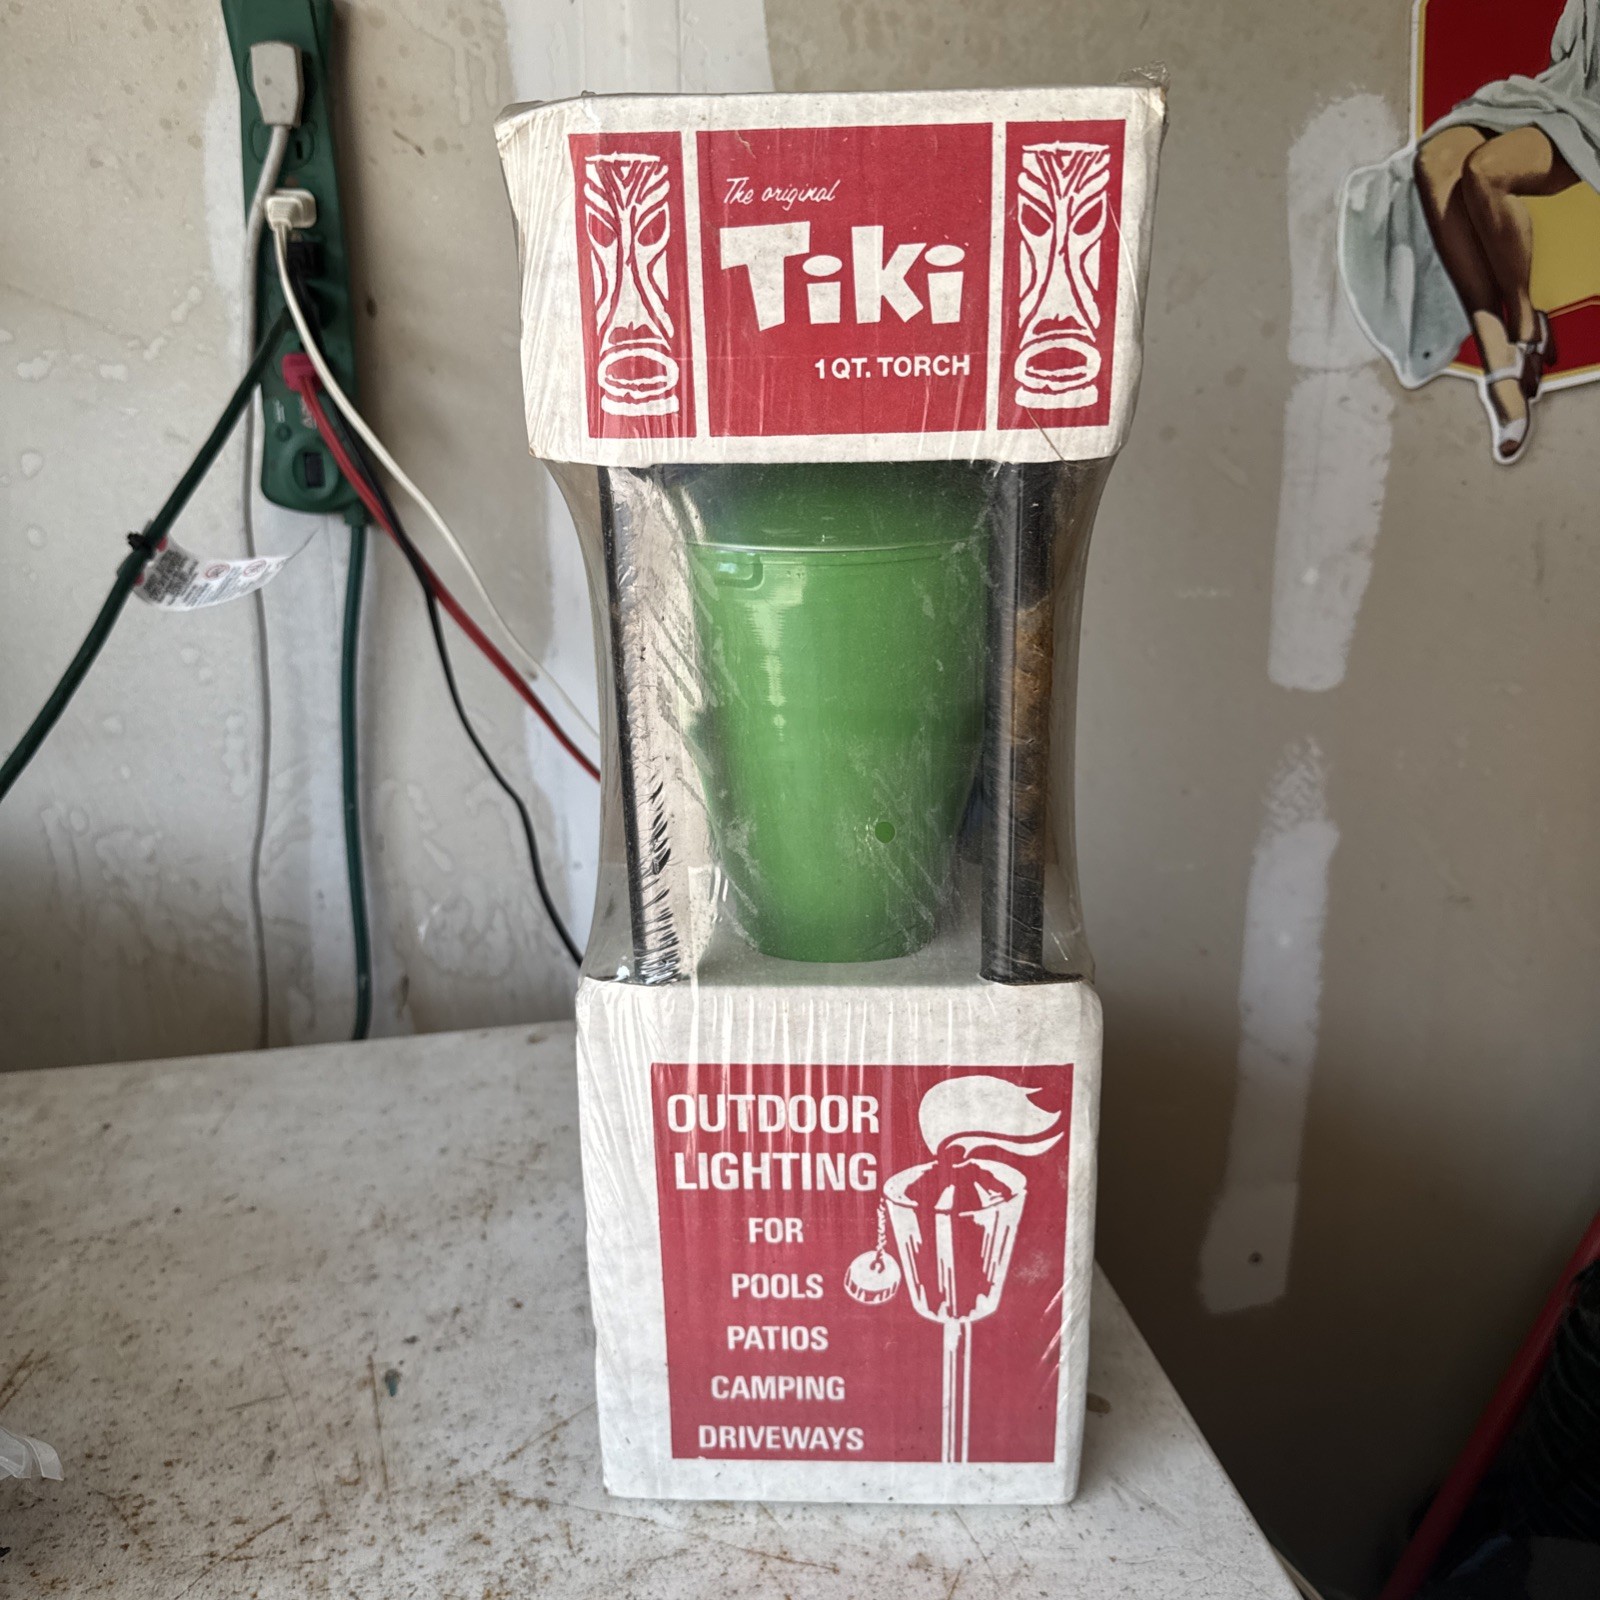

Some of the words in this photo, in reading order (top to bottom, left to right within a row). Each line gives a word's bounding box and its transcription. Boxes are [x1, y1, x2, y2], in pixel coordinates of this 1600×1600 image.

[724, 177, 754, 204] The
[761, 179, 842, 212] original
[720, 221, 965, 332] Tiki
[815, 359, 826, 379] 1
[831, 358, 871, 379] QT.
[877, 355, 970, 377] TORCH
[667, 1094, 880, 1134] OUTDOOR
[674, 1152, 878, 1191] LIGHTING
[748, 1217, 804, 1243] FOR
[731, 1273, 824, 1299] POOLS
[727, 1325, 829, 1351] PATIOS
[710, 1374, 846, 1401] CAMPING
[698, 1425, 865, 1451] DRIVEWAYS
